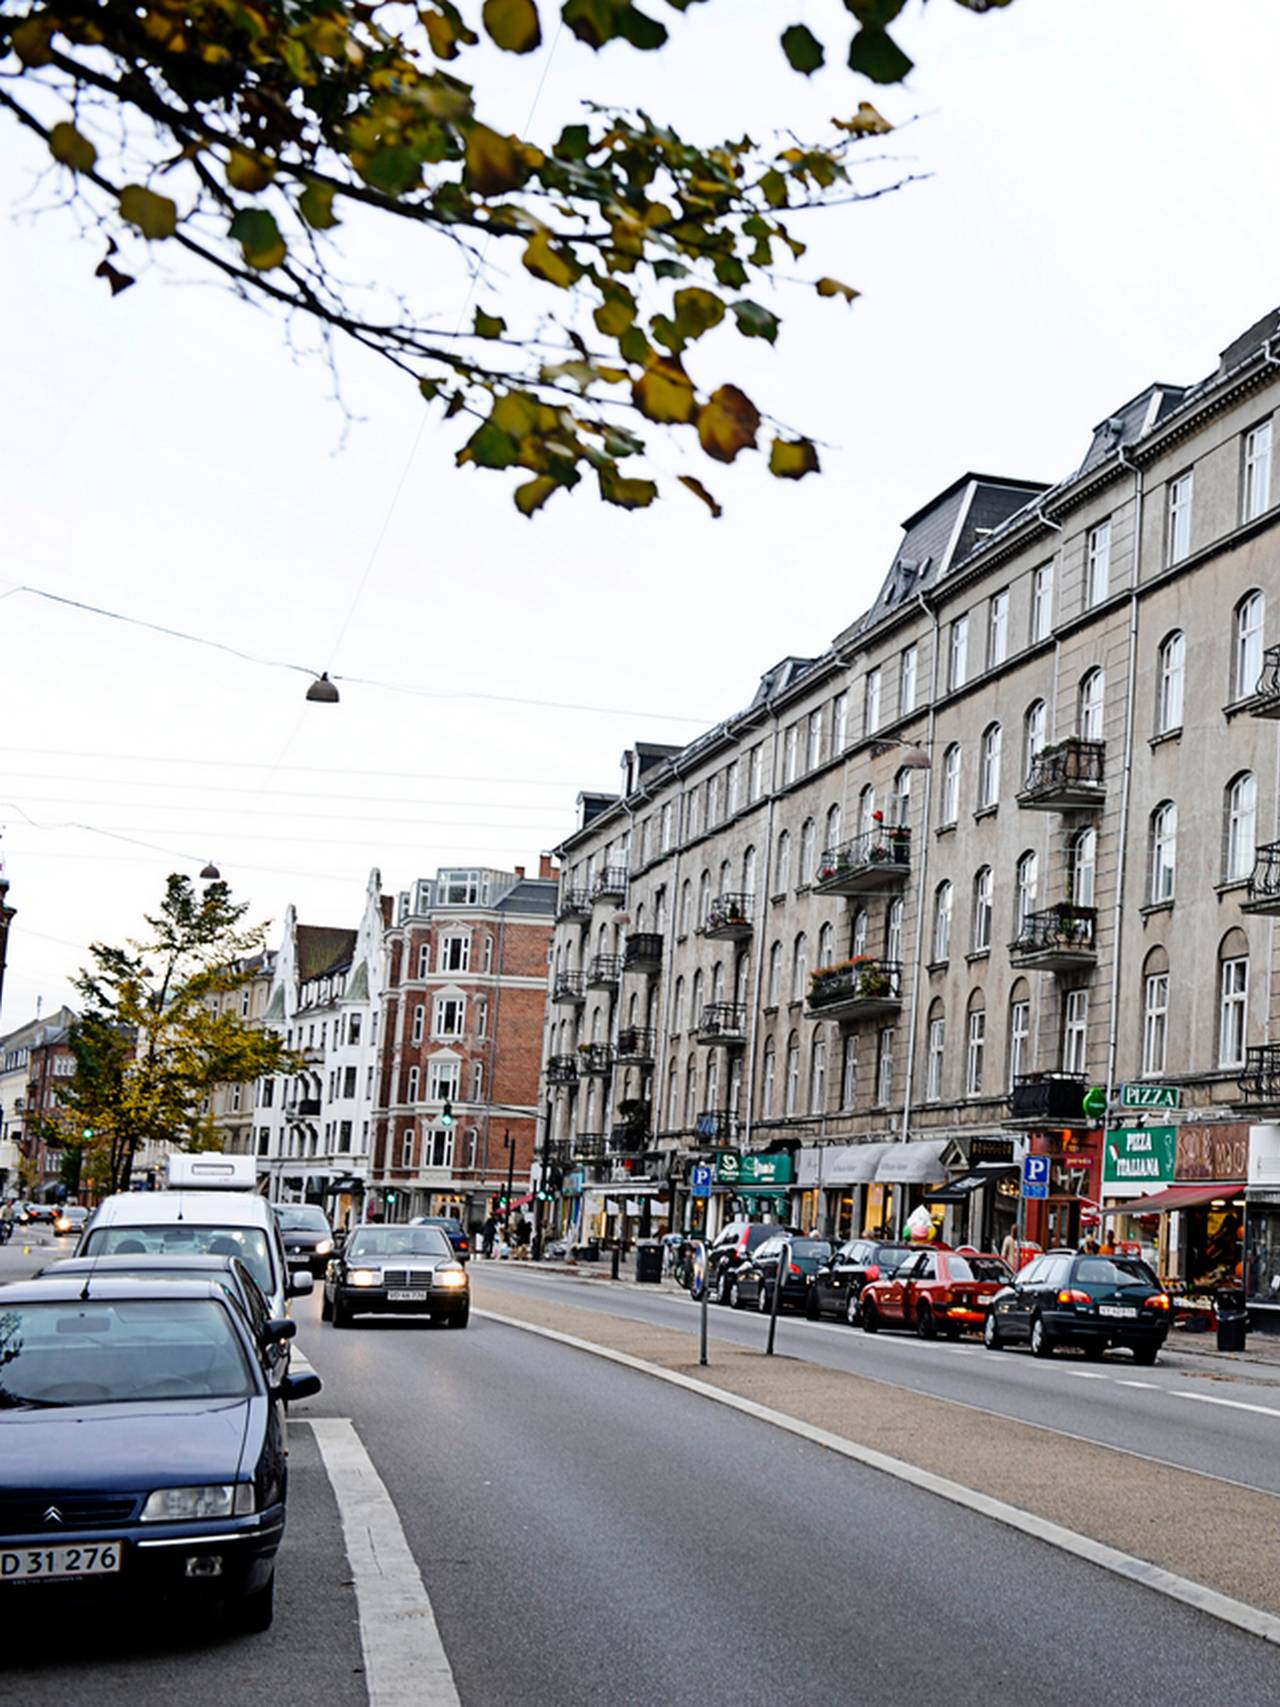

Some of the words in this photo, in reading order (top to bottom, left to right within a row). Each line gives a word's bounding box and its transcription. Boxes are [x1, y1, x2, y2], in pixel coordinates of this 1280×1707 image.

[1126, 1088, 1174, 1106] PIZZA
[1126, 1132, 1153, 1151] PIZZA
[697, 1168, 708, 1184] P
[1028, 1159, 1045, 1180] P
[1117, 1157, 1160, 1176] ITALIANA
[1, 1553, 20, 1575] D
[27, 1552, 54, 1574] 31
[65, 1547, 116, 1570] 276
